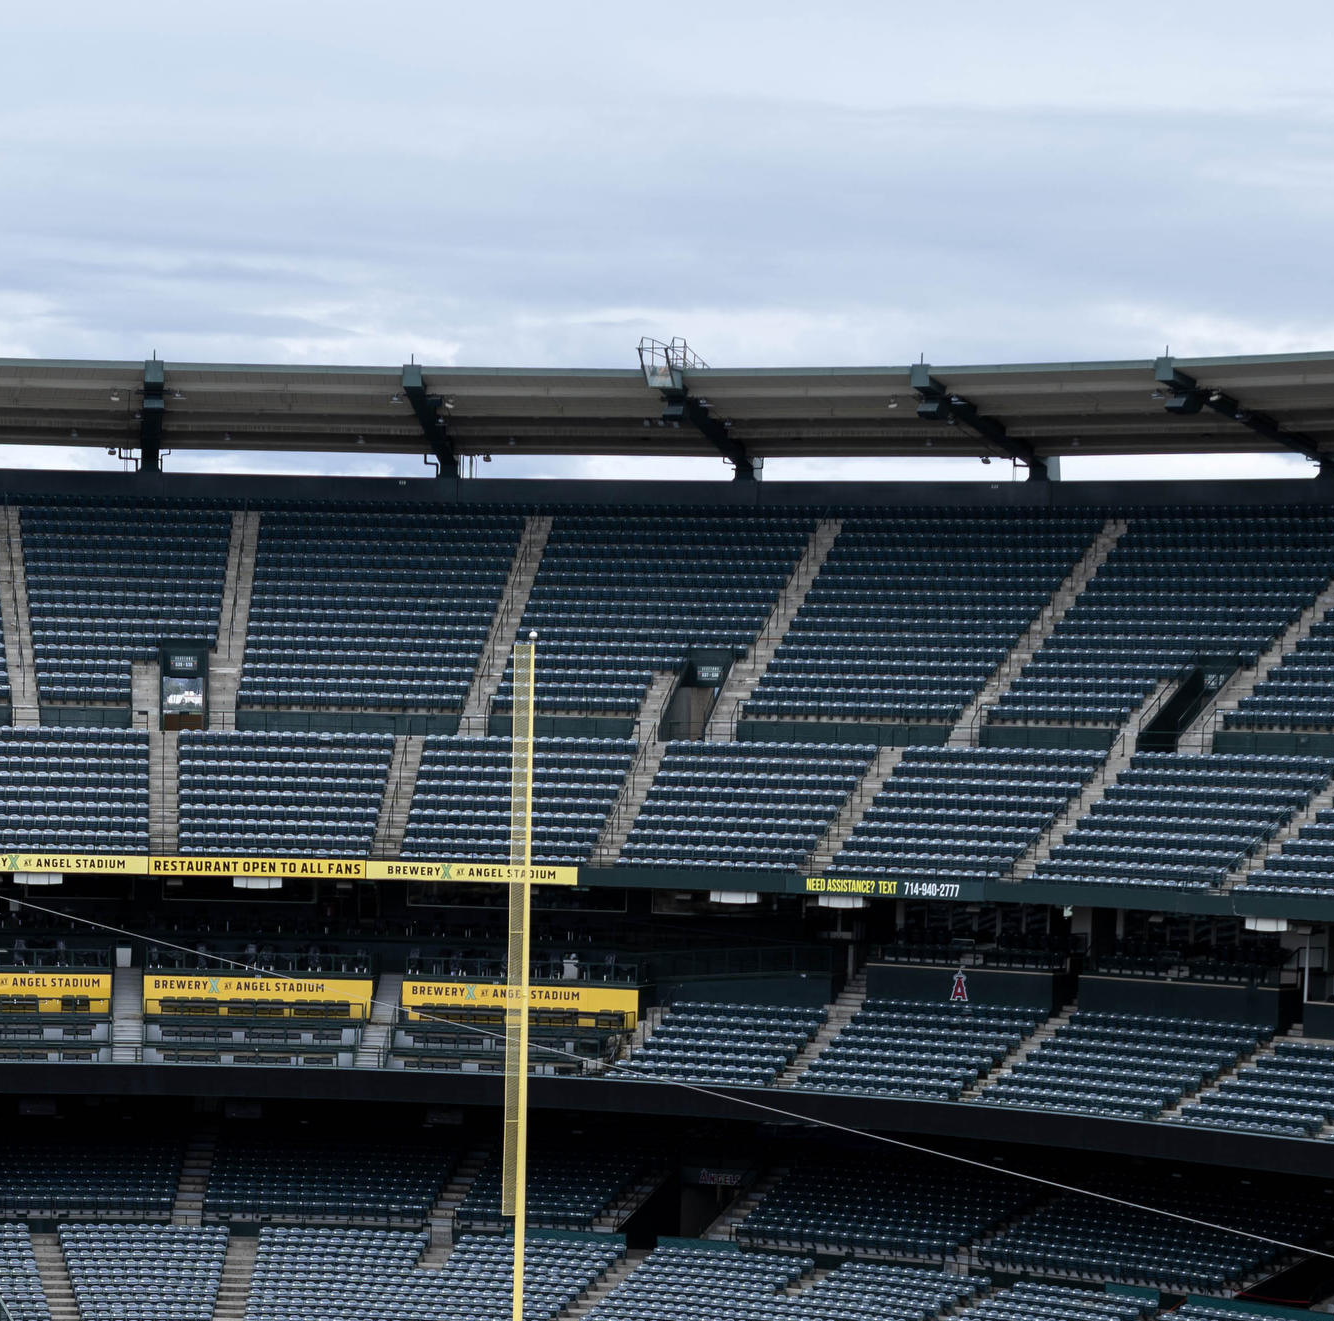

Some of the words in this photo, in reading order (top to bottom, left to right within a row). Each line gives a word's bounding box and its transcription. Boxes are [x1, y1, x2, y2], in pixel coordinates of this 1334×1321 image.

[36, 858, 72, 868] ANGEL
[75, 859, 125, 869] STADIUM
[154, 860, 238, 872] RESTAURANT
[242, 862, 276, 873] OPEN
[280, 862, 296, 873] TO
[300, 862, 323, 873] ALL
[327, 863, 361, 875] FANS
[468, 868, 503, 878] ANGEL
[507, 869, 556, 880] STADIUM
[806, 878, 826, 891] NEED
[827, 879, 875, 894] ASSISTANCE?
[878, 881, 897, 894] TEXT
[904, 882, 959, 898] 714-940-2777
[12, 977, 47, 987] ANGEL
[51, 978, 100, 988] STADIUM
[236, 981, 271, 992] ANGEL
[275, 983, 325, 993] STADIUM
[531, 990, 580, 1001] STADIUM
